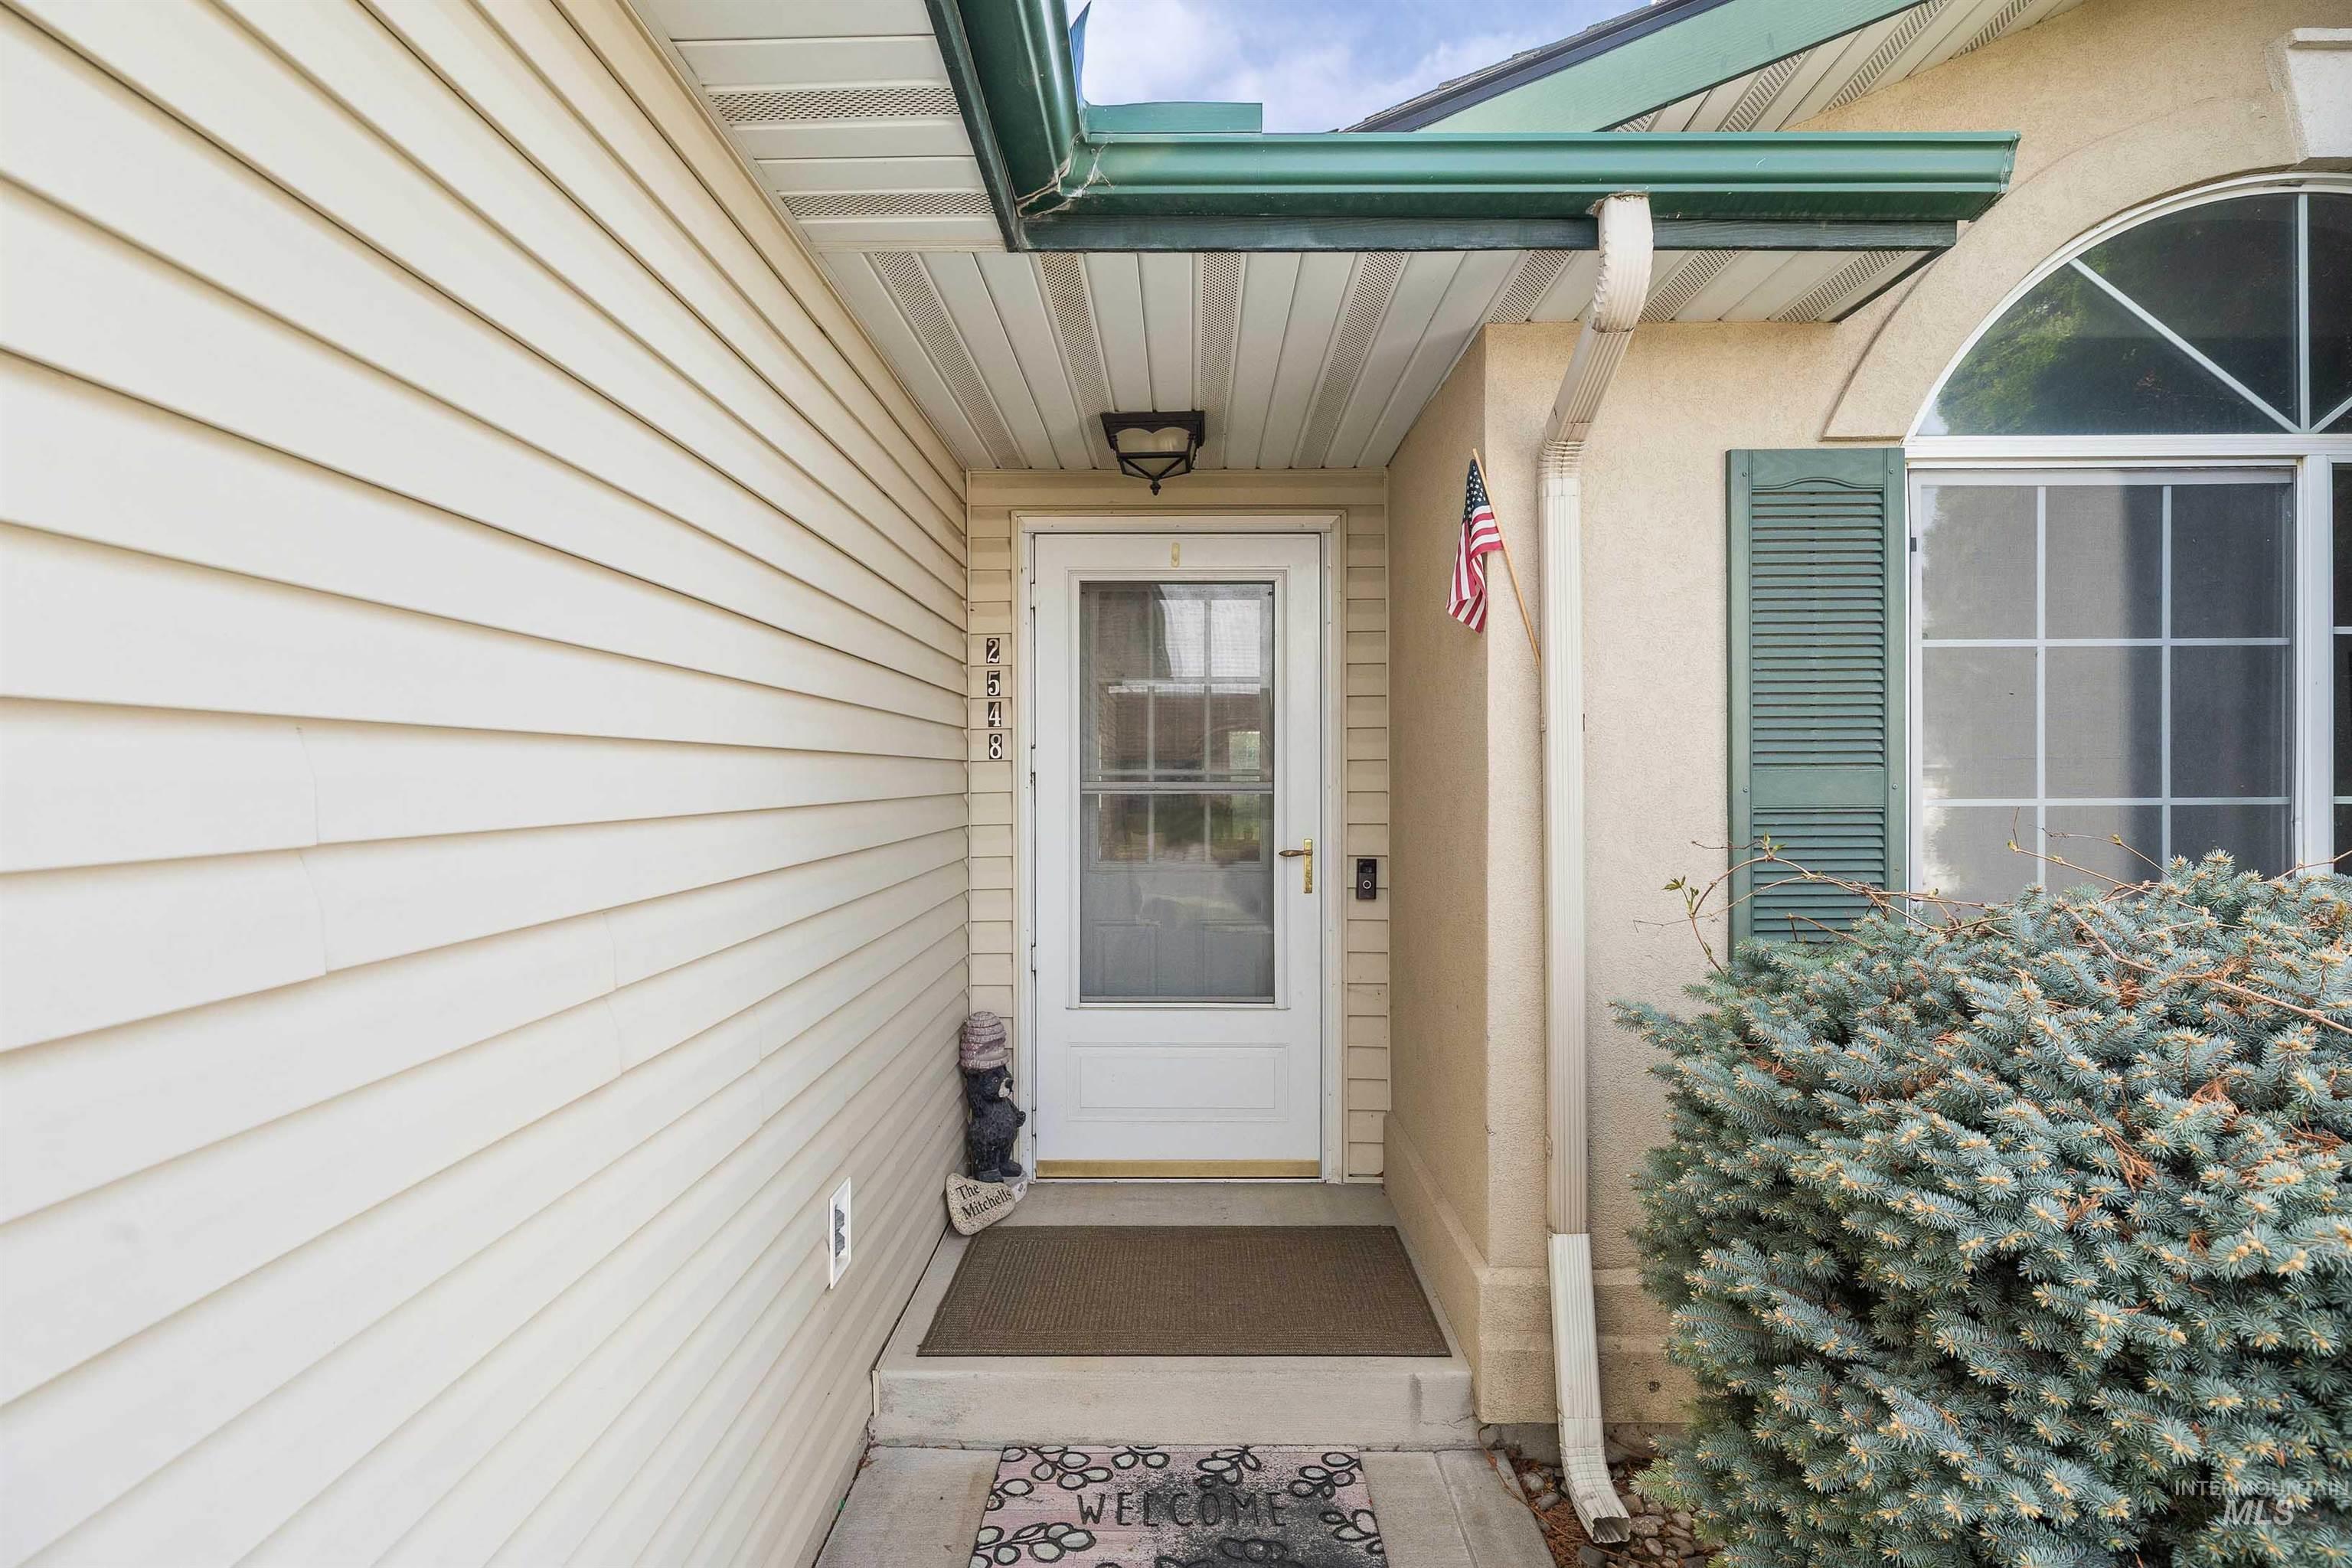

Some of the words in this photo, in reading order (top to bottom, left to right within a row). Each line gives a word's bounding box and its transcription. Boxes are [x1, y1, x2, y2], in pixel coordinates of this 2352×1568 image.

[986, 639, 1002, 760] 2548
[956, 1184, 980, 1200] The
[962, 1189, 1012, 1220] Mitchells
[1076, 1492, 1287, 1527] WELCOME
